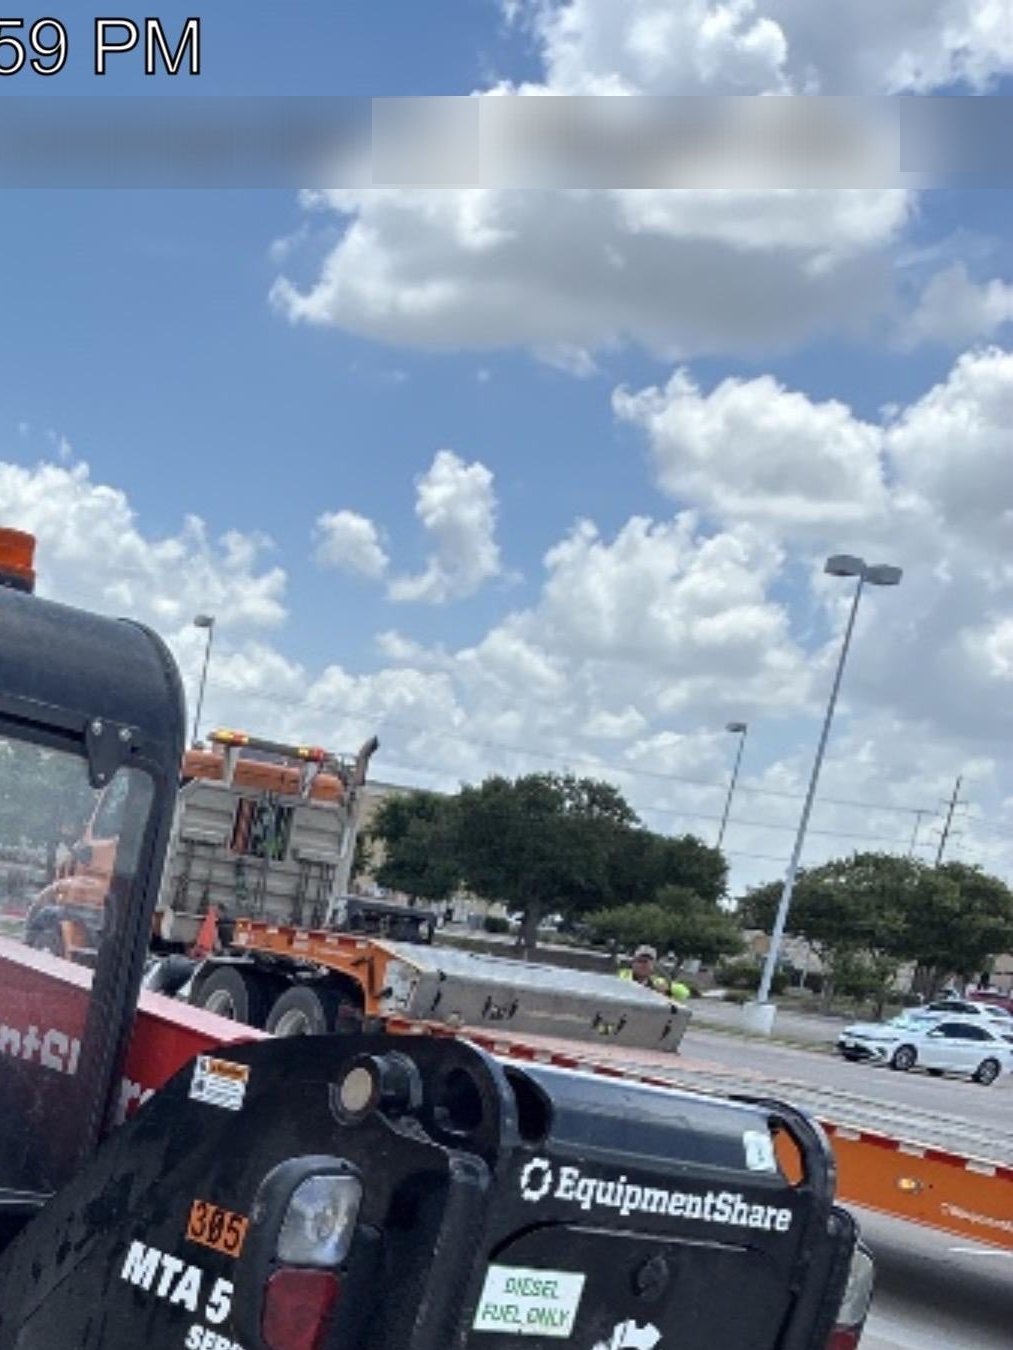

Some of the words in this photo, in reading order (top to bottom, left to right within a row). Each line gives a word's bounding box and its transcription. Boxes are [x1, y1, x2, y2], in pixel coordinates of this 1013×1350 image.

[554, 1166, 792, 1231] EquipmentShare
[191, 1202, 243, 1250] 305
[121, 1240, 203, 1312] MTA
[205, 1277, 234, 1324] 5
[504, 1277, 560, 1300] DIESEL
[482, 1303, 522, 1324] FUEL
[527, 1307, 571, 1328] ONLY
